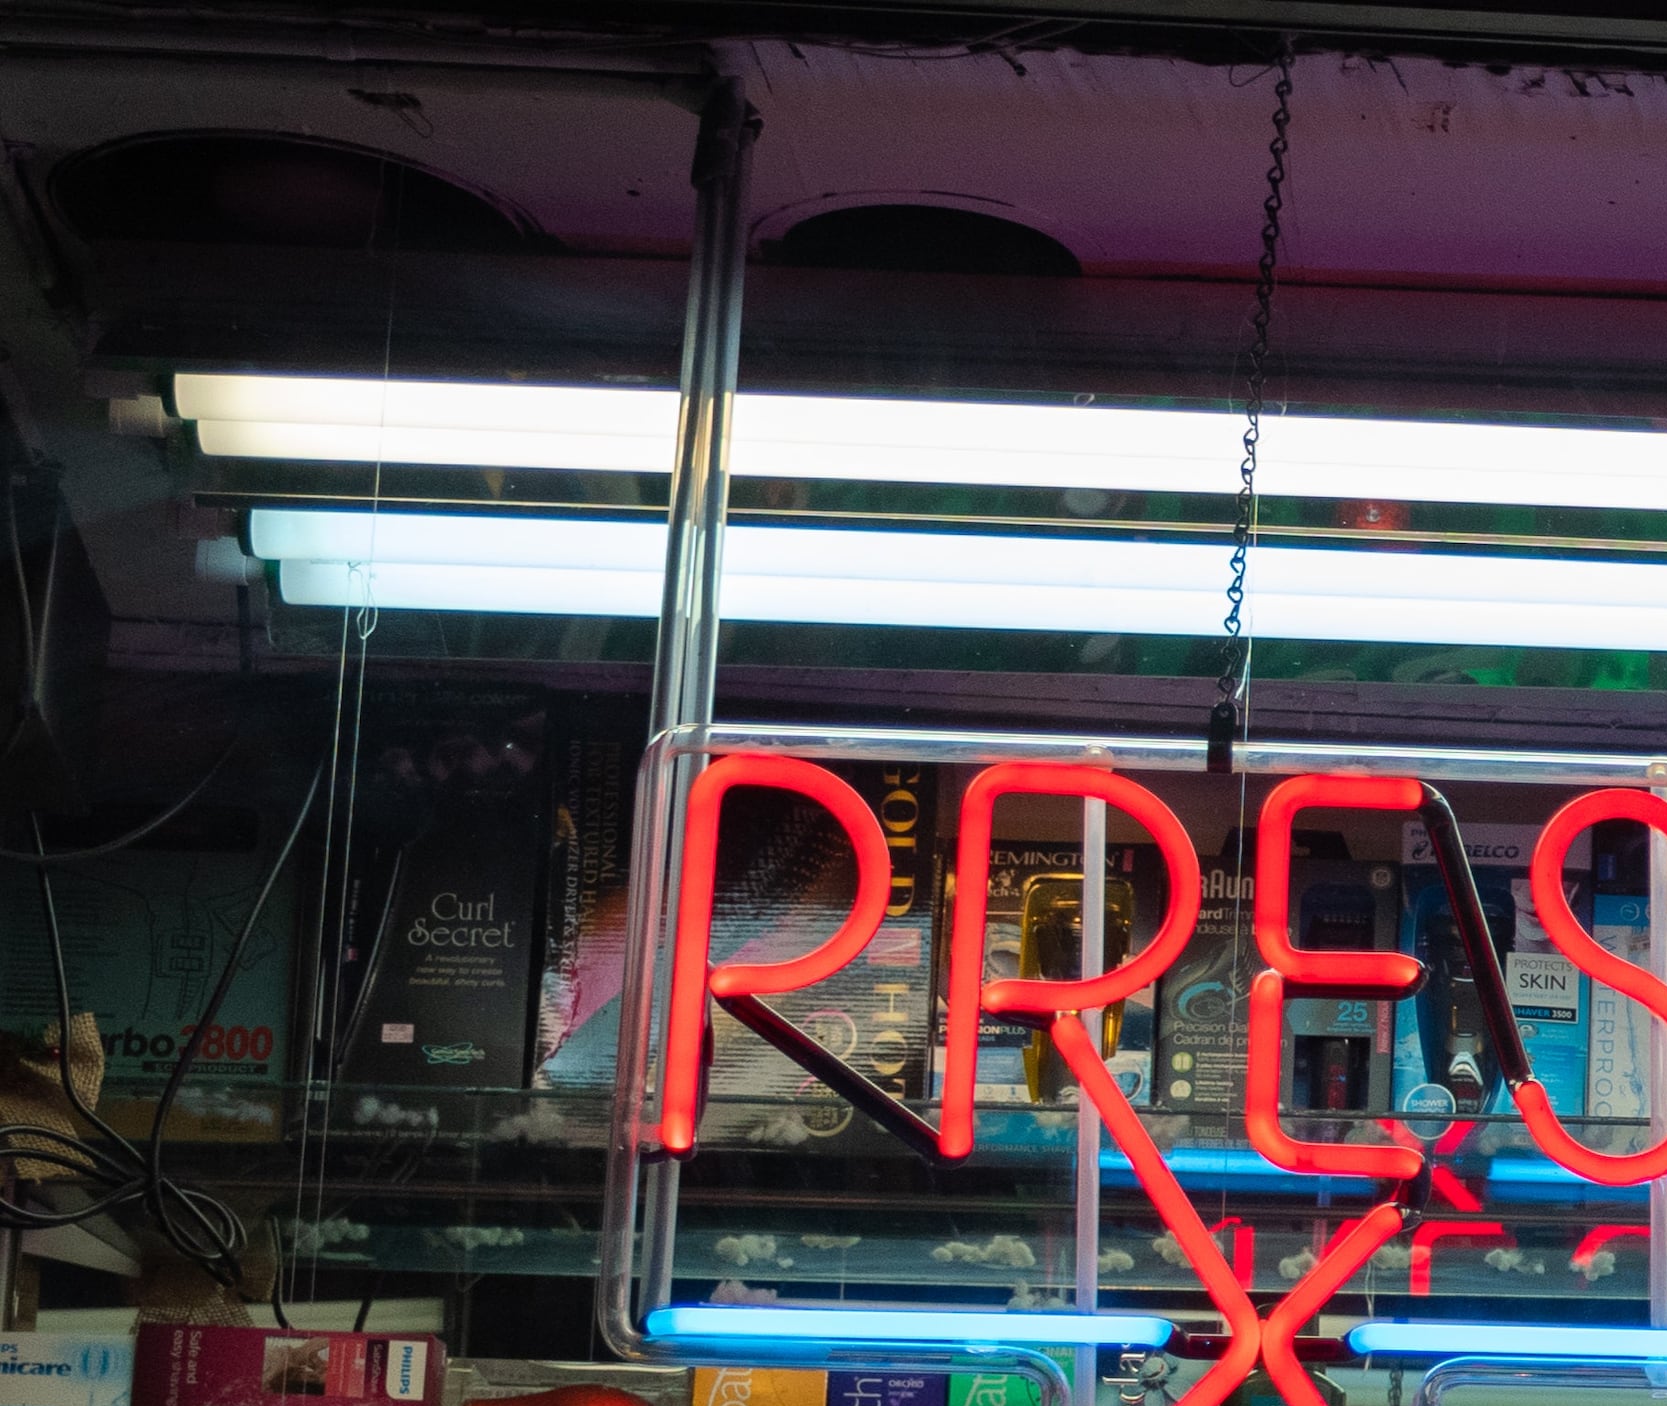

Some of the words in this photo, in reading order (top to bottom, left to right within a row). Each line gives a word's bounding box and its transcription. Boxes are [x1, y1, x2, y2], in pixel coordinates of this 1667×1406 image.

[431, 892, 495, 921] Curl
[408, 917, 515, 948] Secret
[1514, 959, 1573, 972] PROTECTS
[1519, 973, 1567, 990] SKIN
[1551, 1009, 1573, 1019] 3500
[188, 1331, 202, 1357] Safe
[164, 1361, 182, 1406] shaving
[400, 1345, 414, 1395] PHILIPS
